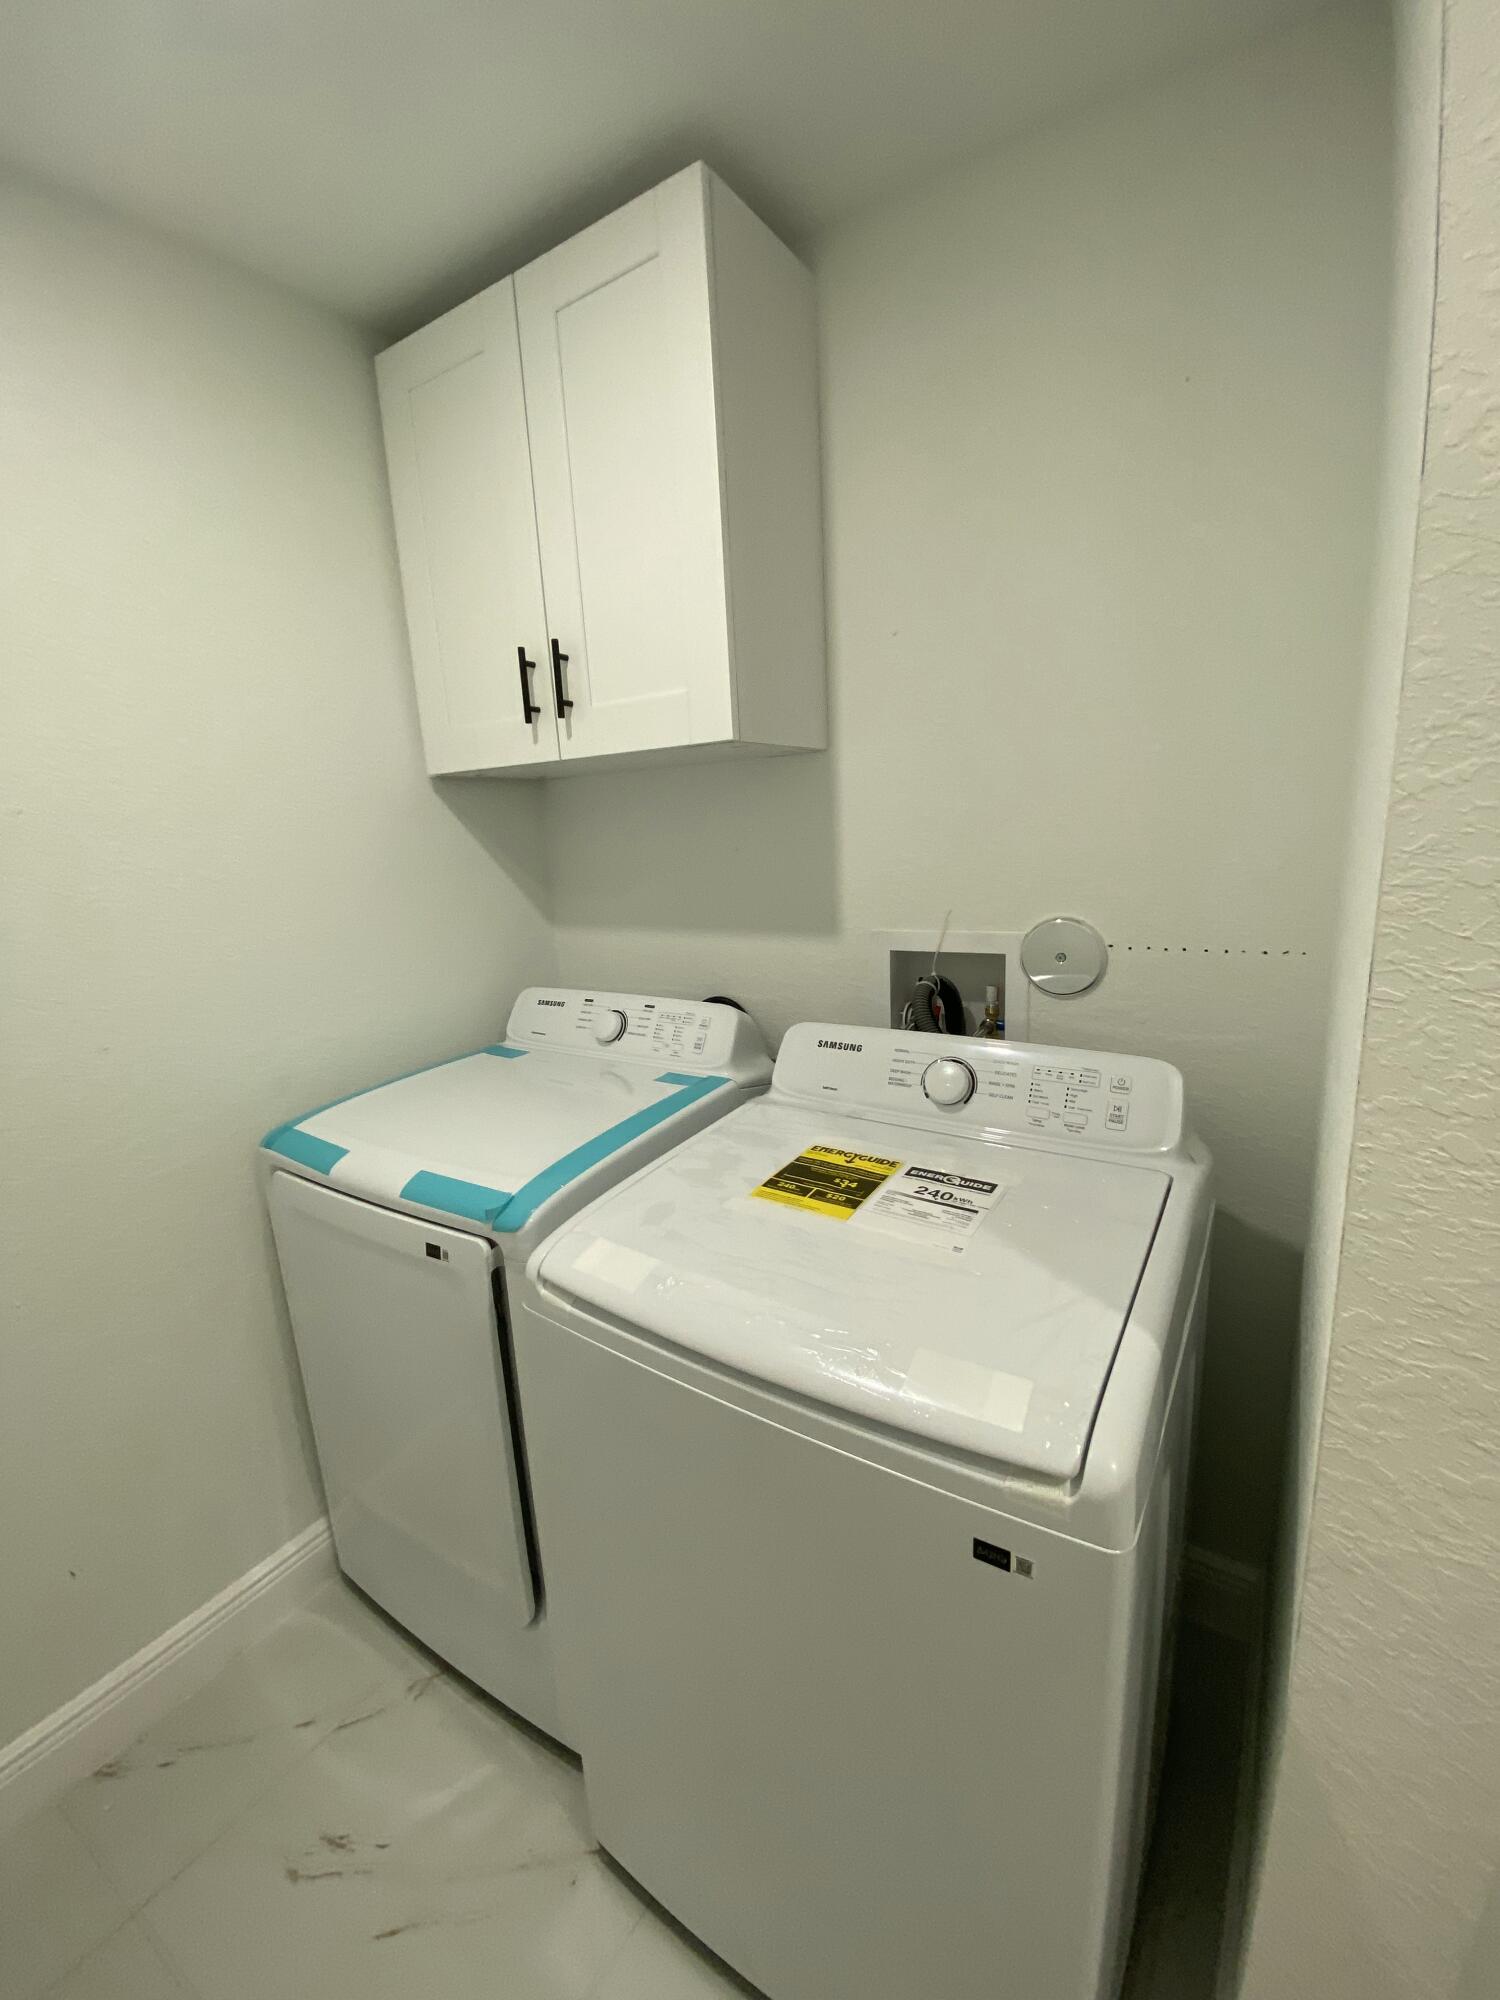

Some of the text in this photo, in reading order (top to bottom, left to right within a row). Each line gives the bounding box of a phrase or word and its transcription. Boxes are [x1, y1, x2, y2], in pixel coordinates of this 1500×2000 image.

[537, 999, 566, 1007] SAMSUNG
[817, 1039, 863, 1053] SAMSUNG
[810, 1145, 901, 1168] ENERGYGUIDE
[913, 1185, 974, 1205] 240 kWh
